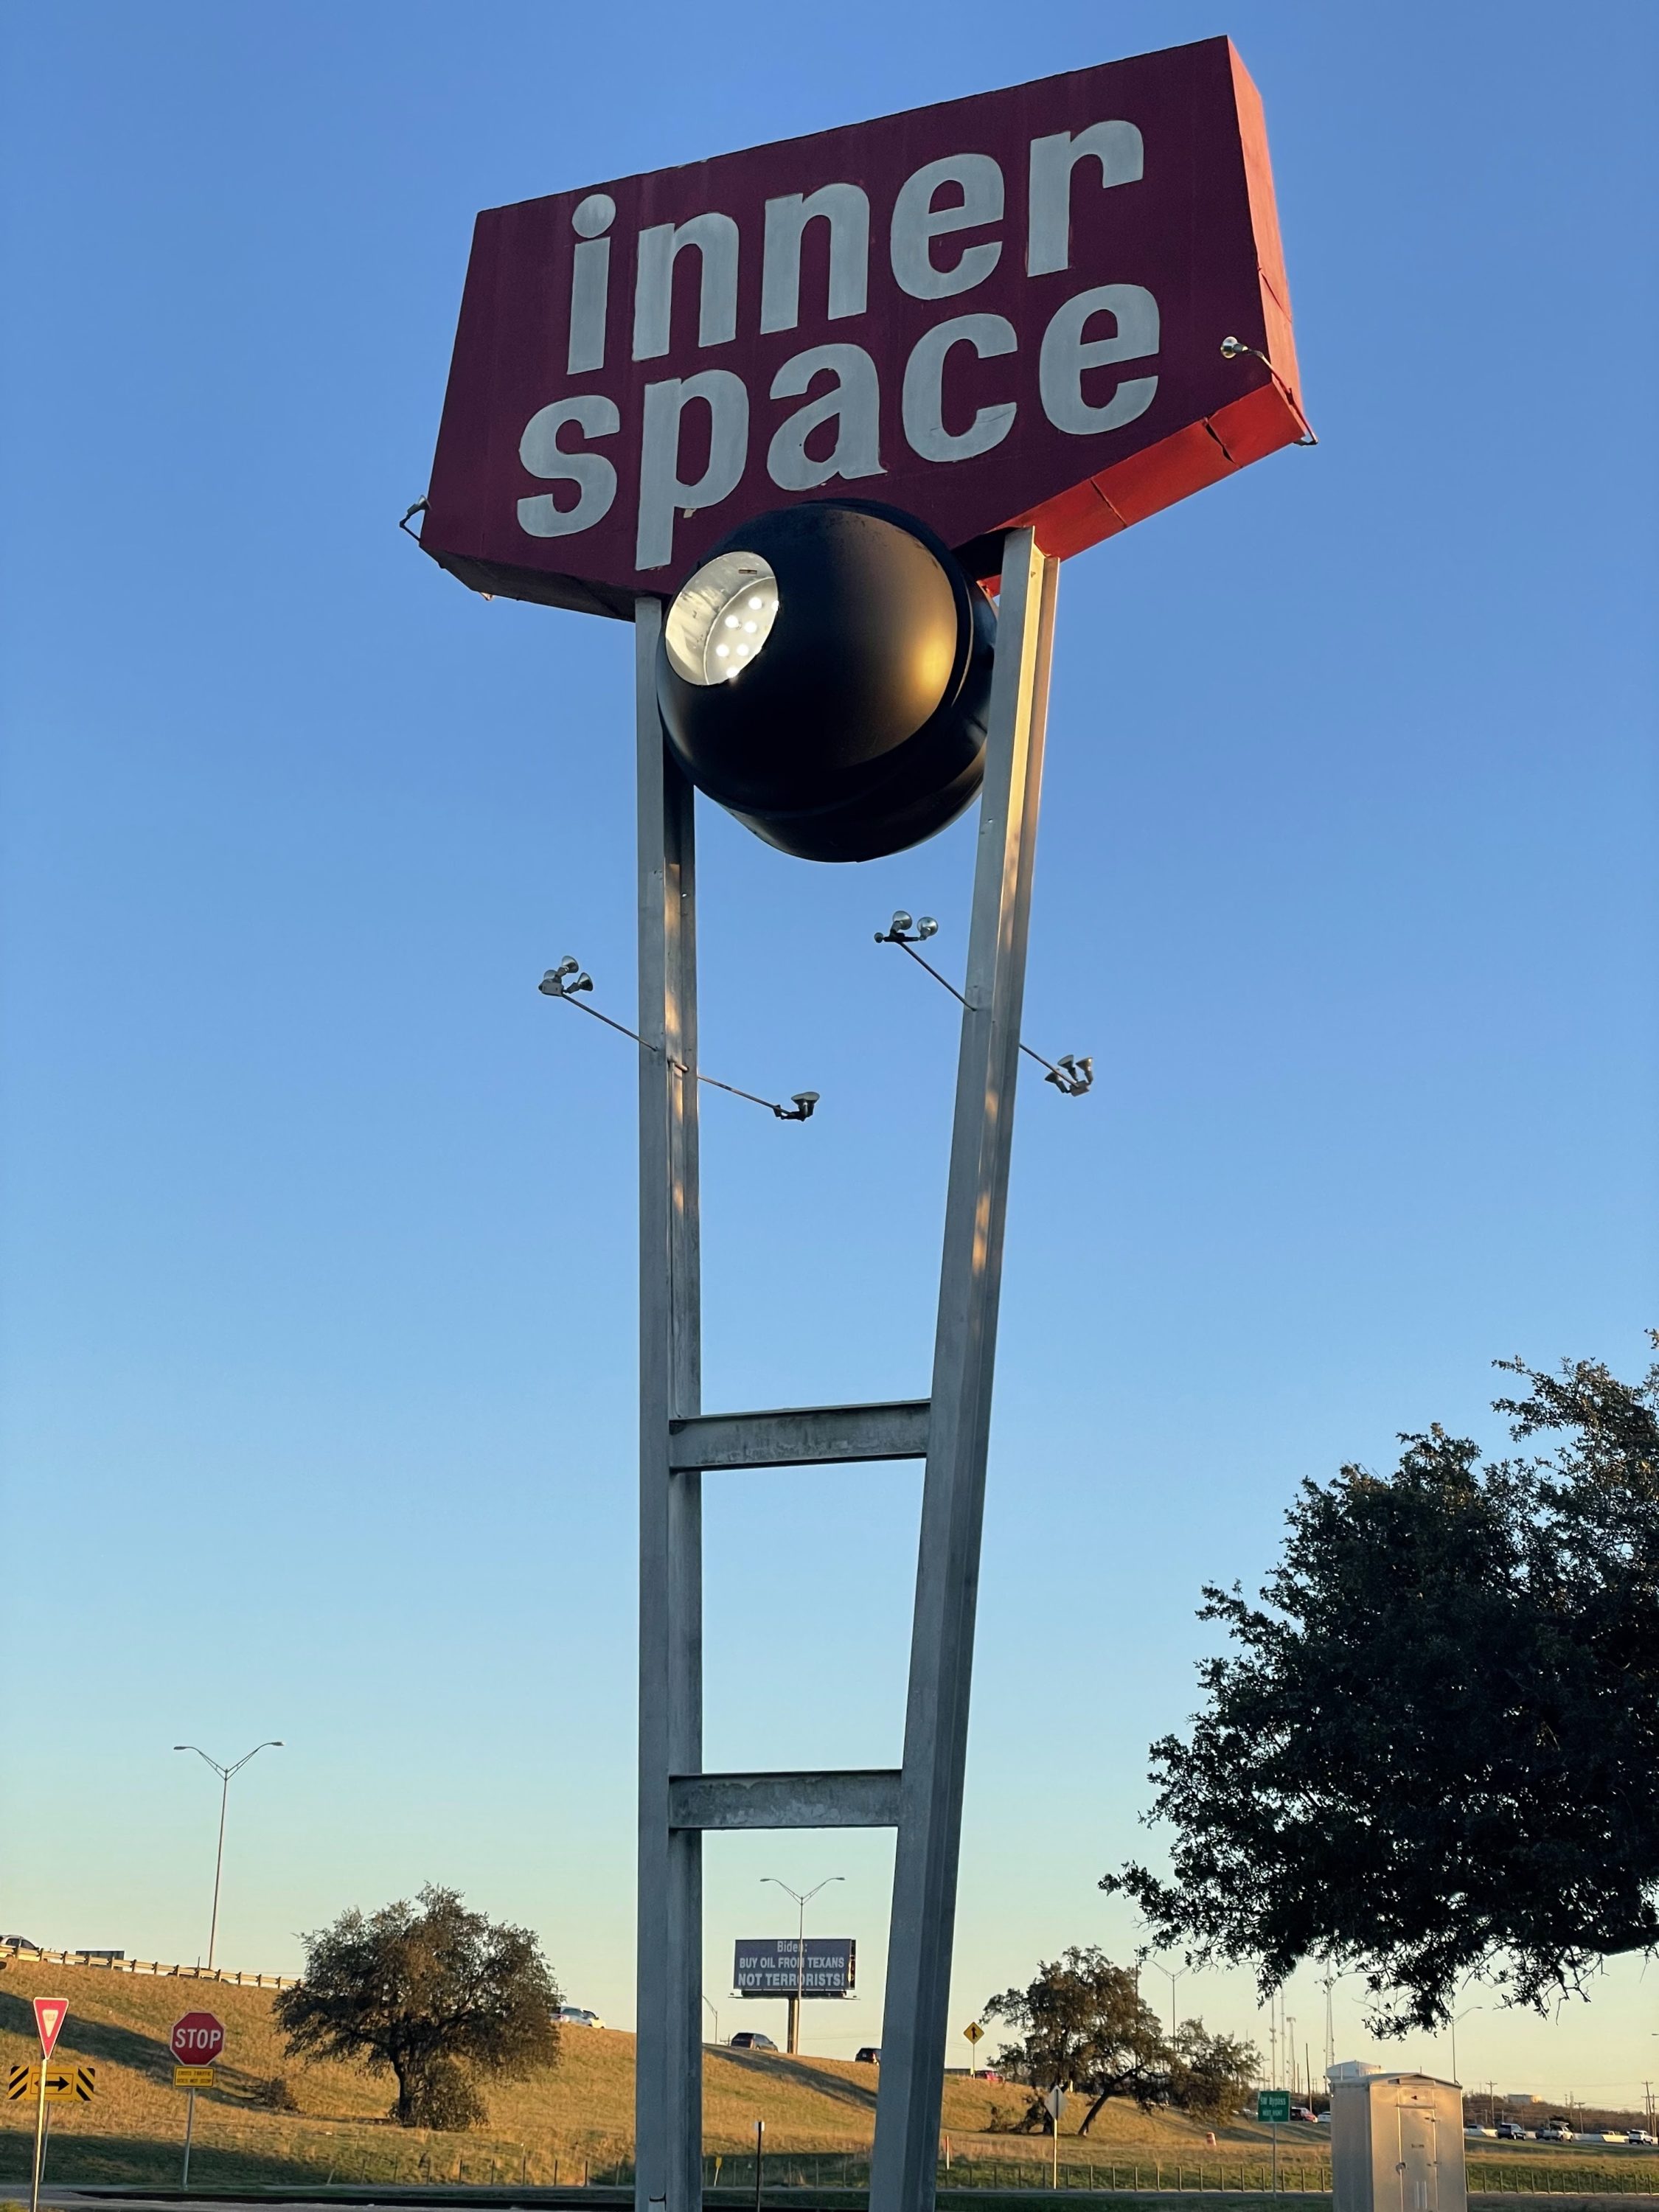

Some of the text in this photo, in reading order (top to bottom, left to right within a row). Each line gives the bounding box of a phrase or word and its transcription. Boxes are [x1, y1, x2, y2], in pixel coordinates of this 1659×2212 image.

[566, 119, 1145, 375] inner
[516, 283, 1161, 571] space
[740, 1957, 845, 1968] BUY OIL FROM TEXANS
[738, 1973, 845, 1986] NOT TERRORISTS!
[175, 2028, 221, 2049] STOP
